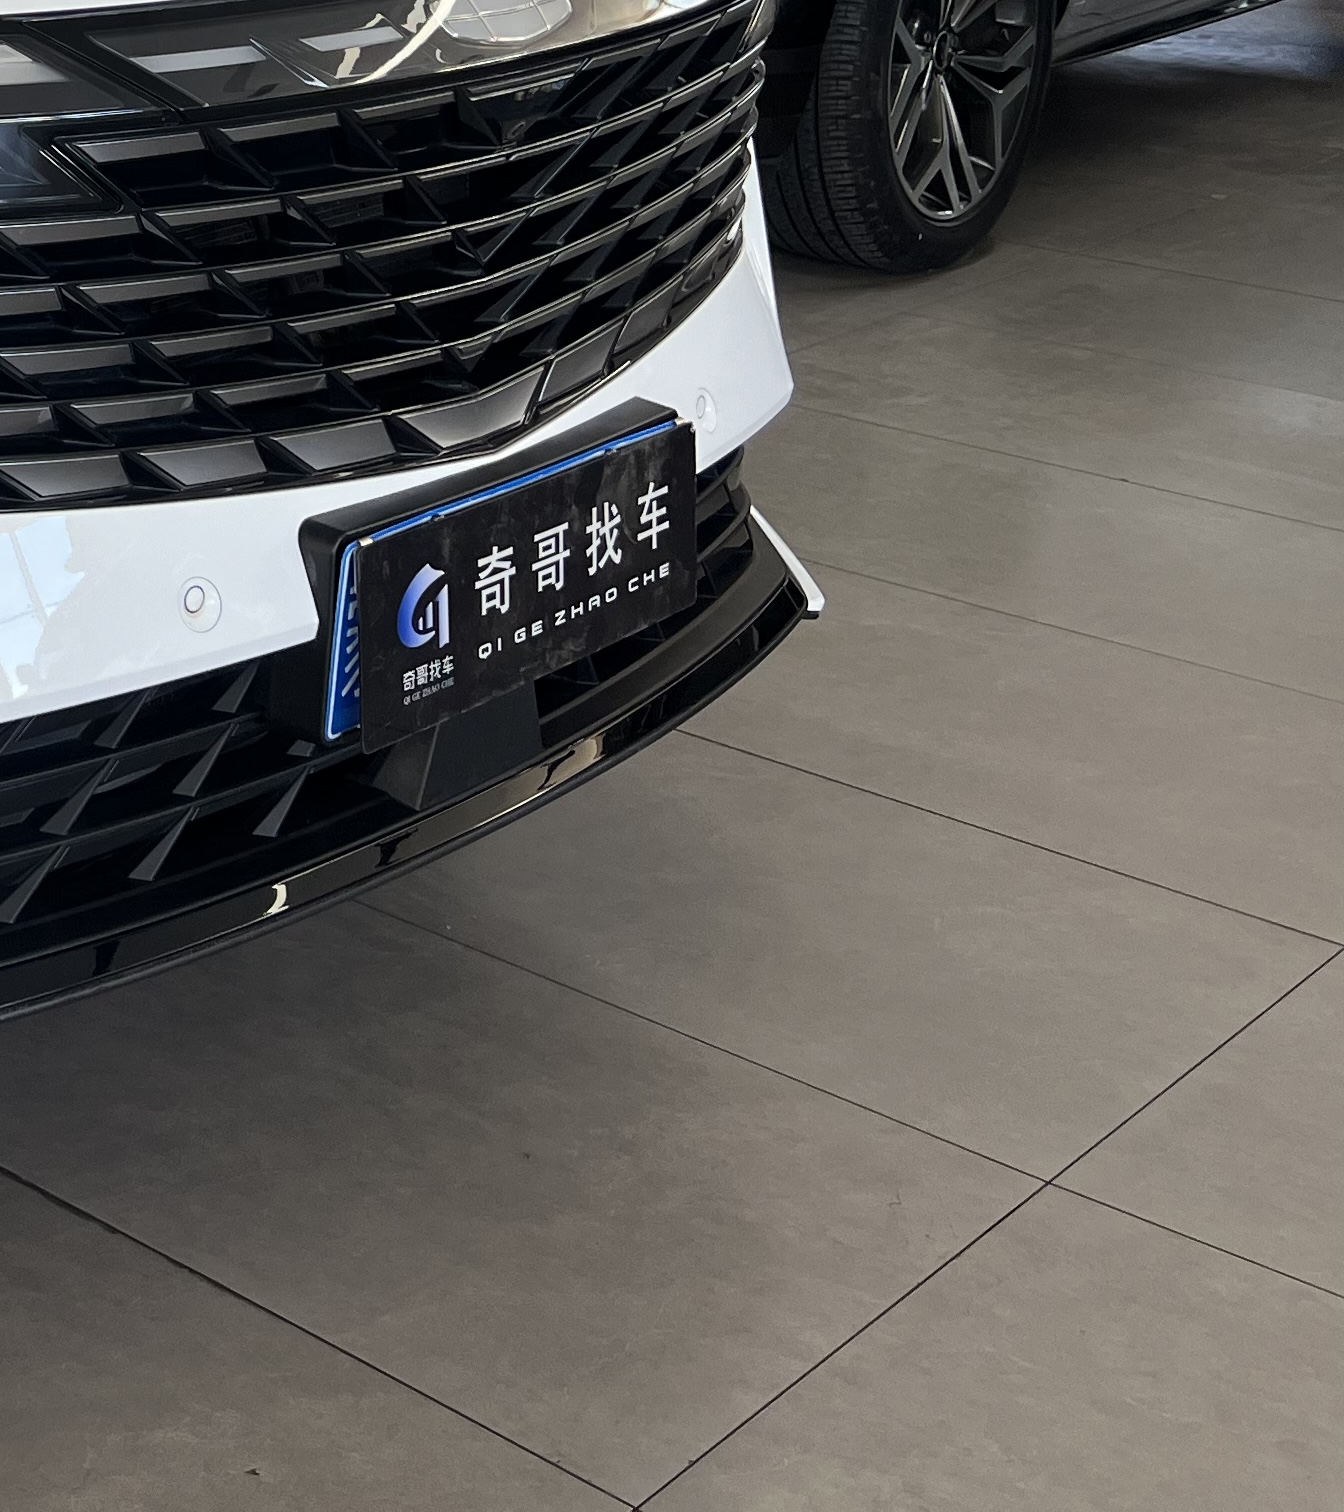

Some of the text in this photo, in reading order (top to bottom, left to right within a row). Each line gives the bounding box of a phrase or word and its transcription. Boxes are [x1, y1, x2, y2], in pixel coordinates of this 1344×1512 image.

[474, 481, 671, 616] 奇哥找车
[478, 562, 671, 660] QI GE ZHAO CHE
[402, 654, 455, 691] 奇哥找车
